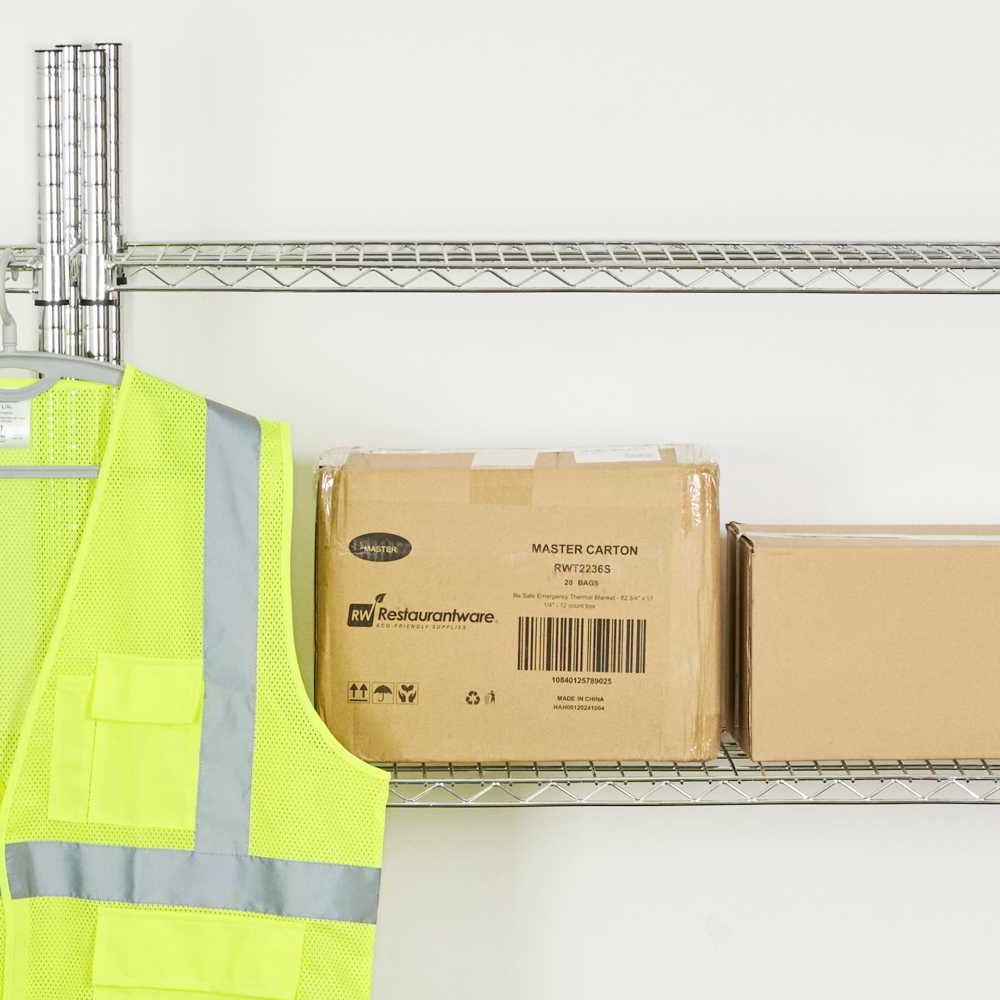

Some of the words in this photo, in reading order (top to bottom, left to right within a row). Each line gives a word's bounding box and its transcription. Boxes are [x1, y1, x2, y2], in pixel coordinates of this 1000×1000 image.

[362, 544, 398, 553] MASTER
[531, 543, 583, 555] MASTER
[586, 544, 638, 556] CARTON
[553, 563, 611, 574] RWT2236S
[577, 579, 599, 587] BAGS
[351, 609, 372, 621] RW
[377, 607, 495, 624] Restaurantware
